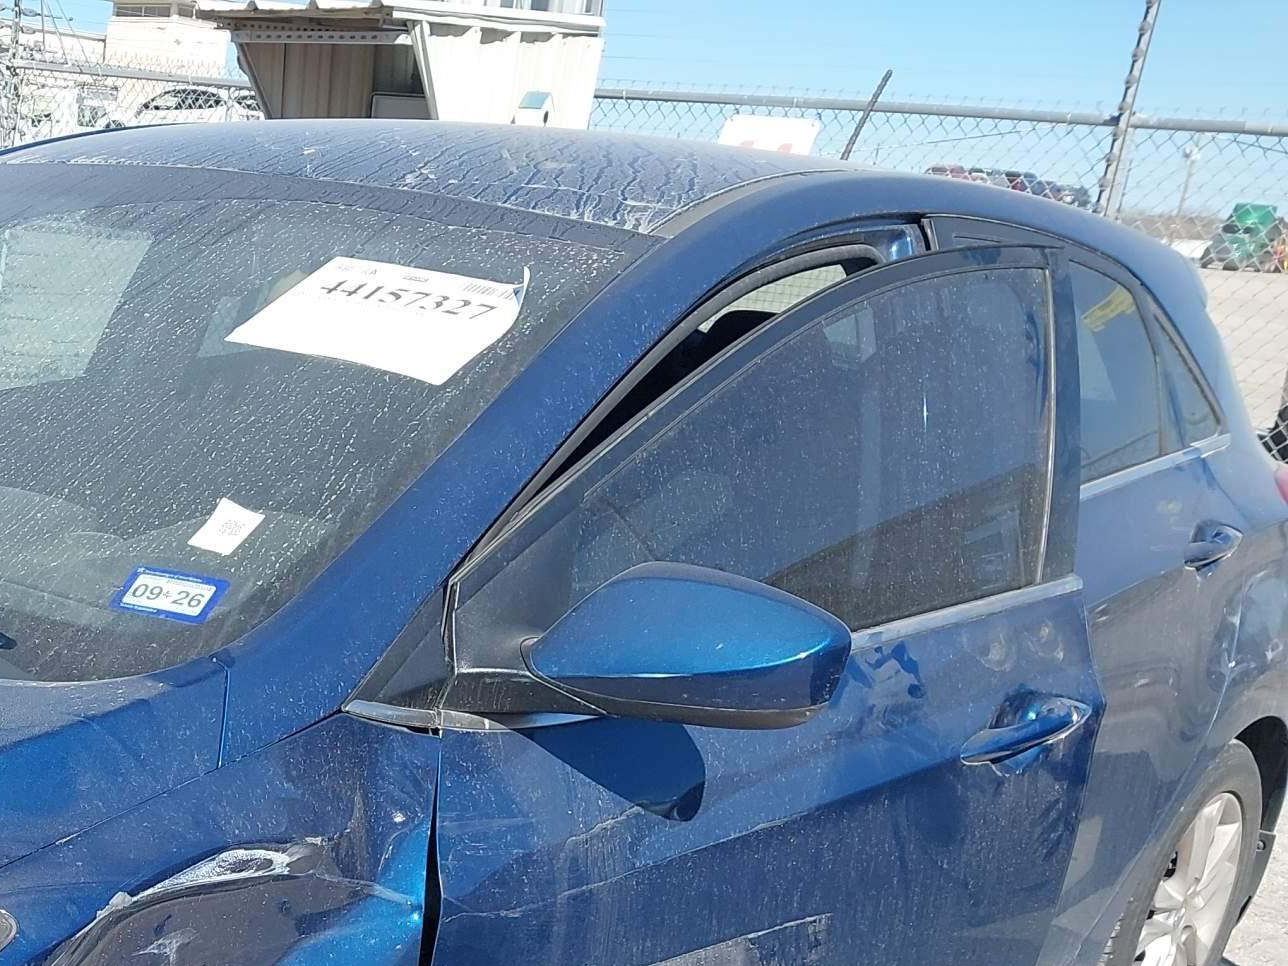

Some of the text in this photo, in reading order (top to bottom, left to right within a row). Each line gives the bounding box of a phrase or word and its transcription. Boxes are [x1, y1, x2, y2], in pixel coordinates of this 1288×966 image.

[320, 279, 497, 320] 44157327
[131, 583, 163, 601] 09
[171, 590, 206, 608] 26
